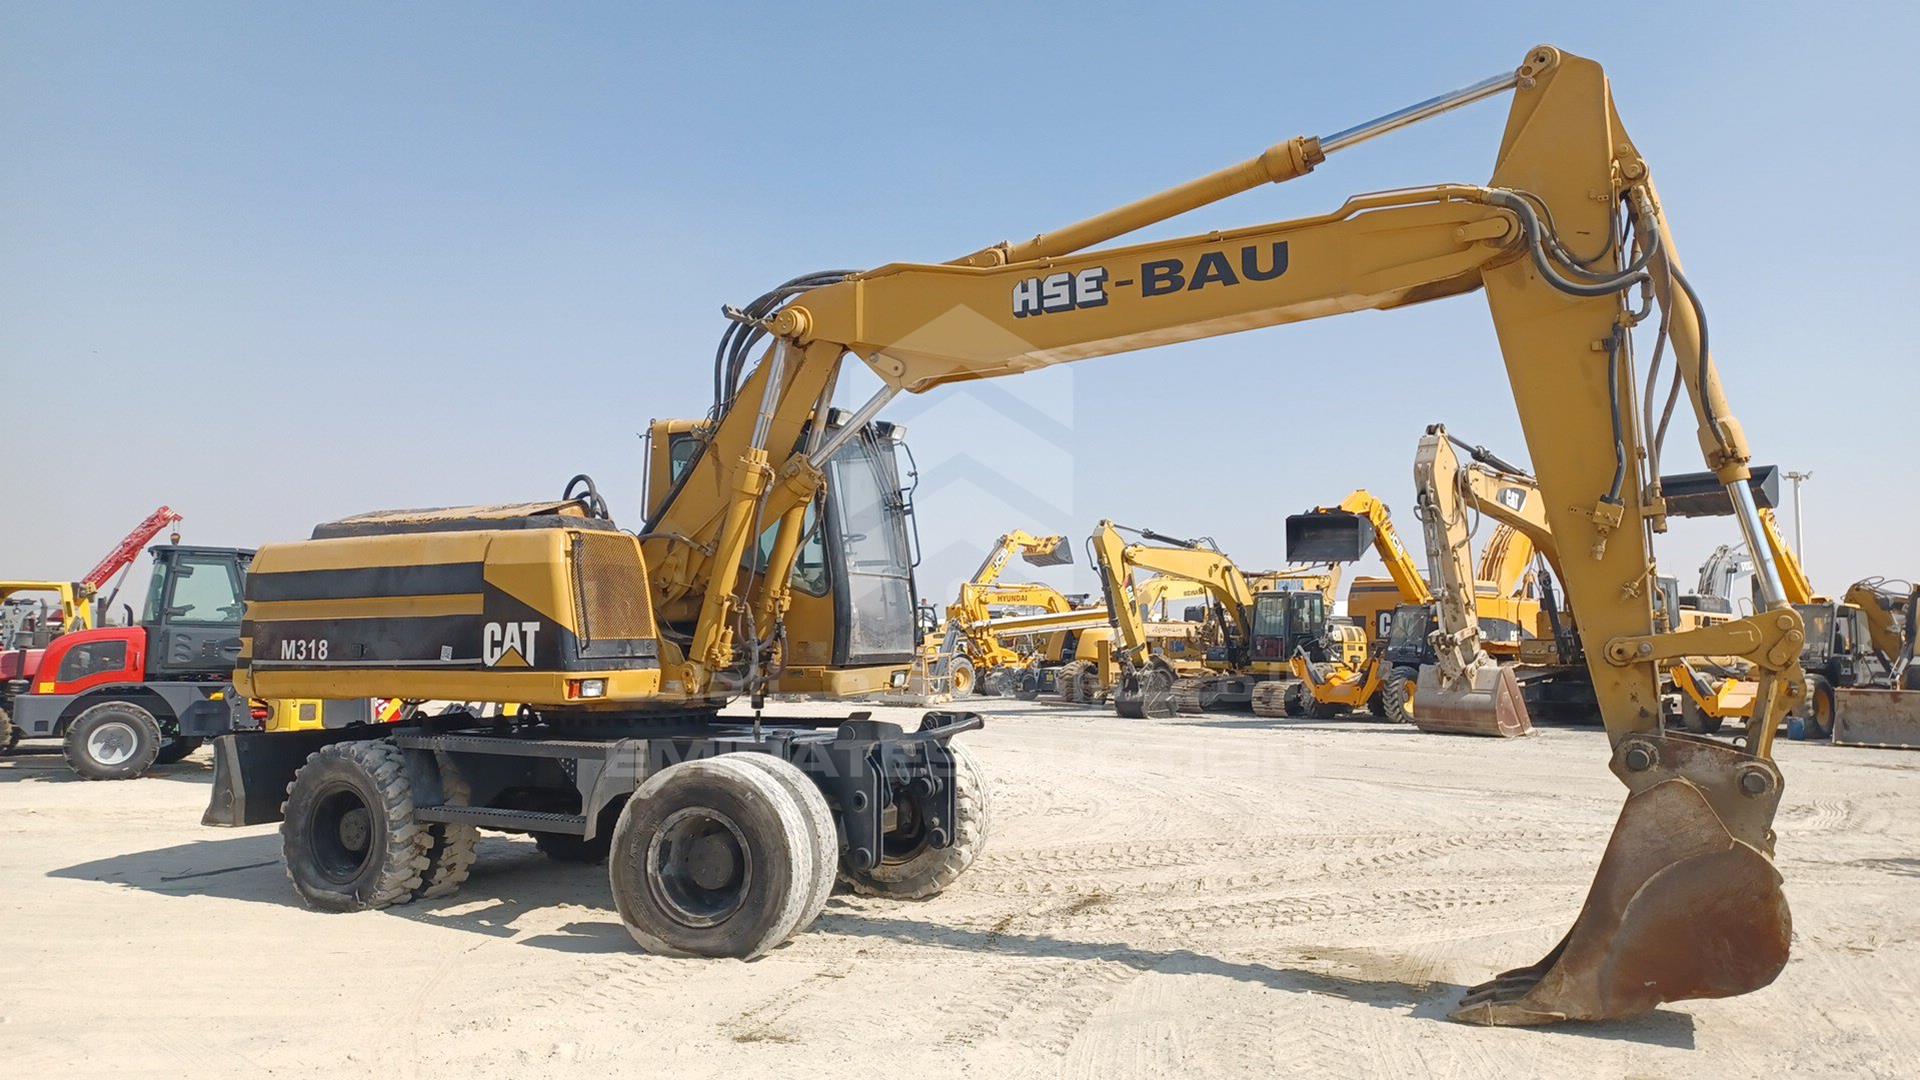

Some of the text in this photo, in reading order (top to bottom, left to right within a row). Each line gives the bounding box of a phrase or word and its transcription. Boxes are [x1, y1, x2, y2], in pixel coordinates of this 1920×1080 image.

[1506, 489, 1520, 509] CAT
[992, 548, 1008, 569] JCB
[997, 594, 1028, 603] HYUNDAI
[280, 639, 329, 661] M318
[483, 622, 541, 668] CAT
